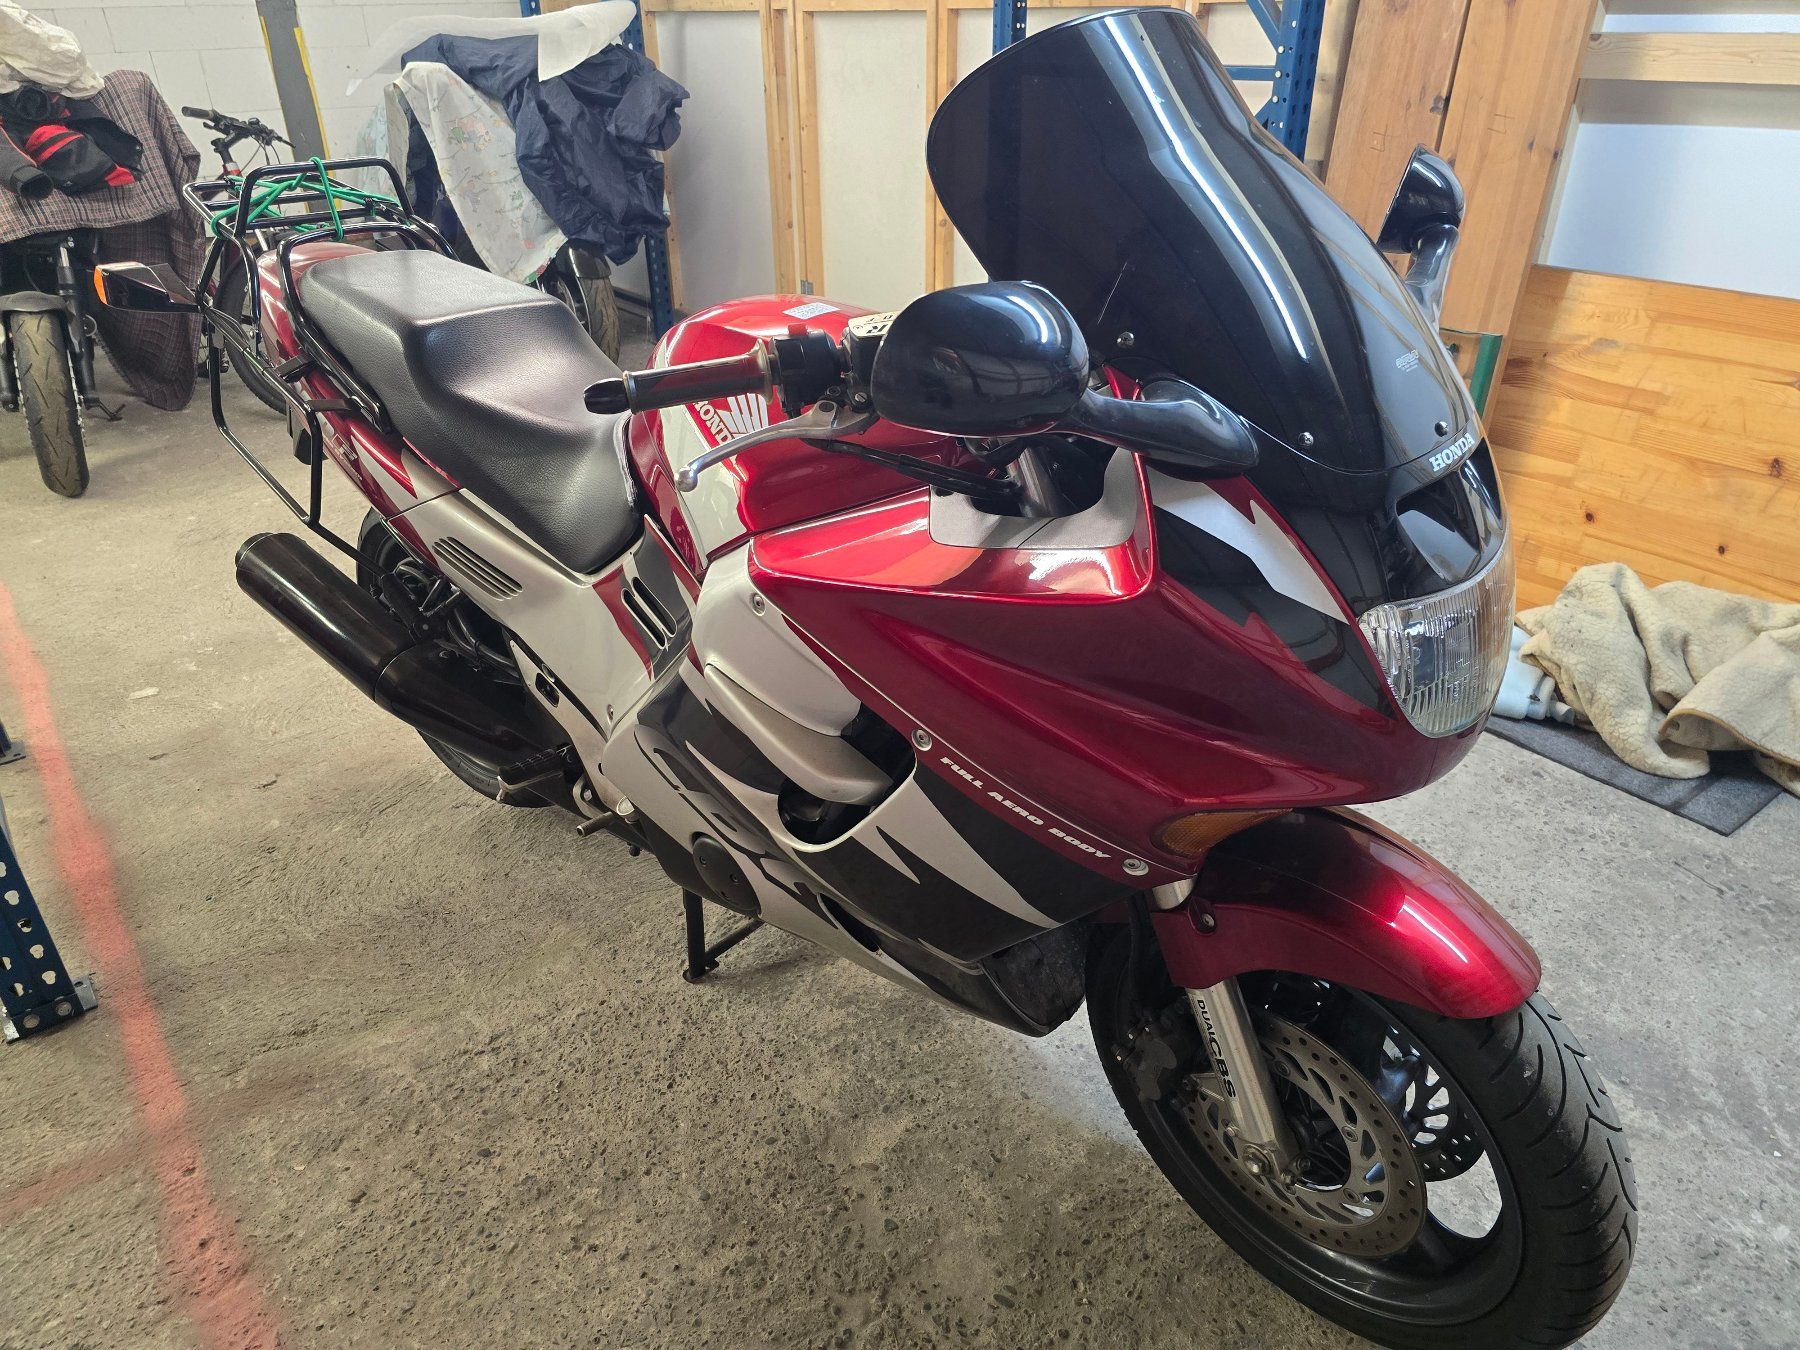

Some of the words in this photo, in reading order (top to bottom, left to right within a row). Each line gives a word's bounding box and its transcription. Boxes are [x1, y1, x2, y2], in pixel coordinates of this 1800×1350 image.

[692, 401, 733, 446] OND
[1428, 432, 1475, 472] HONDA
[940, 757, 984, 789] FULL
[987, 791, 1044, 826] AERO
[1048, 828, 1111, 858] BODY
[1208, 1036, 1236, 1098] CBS
